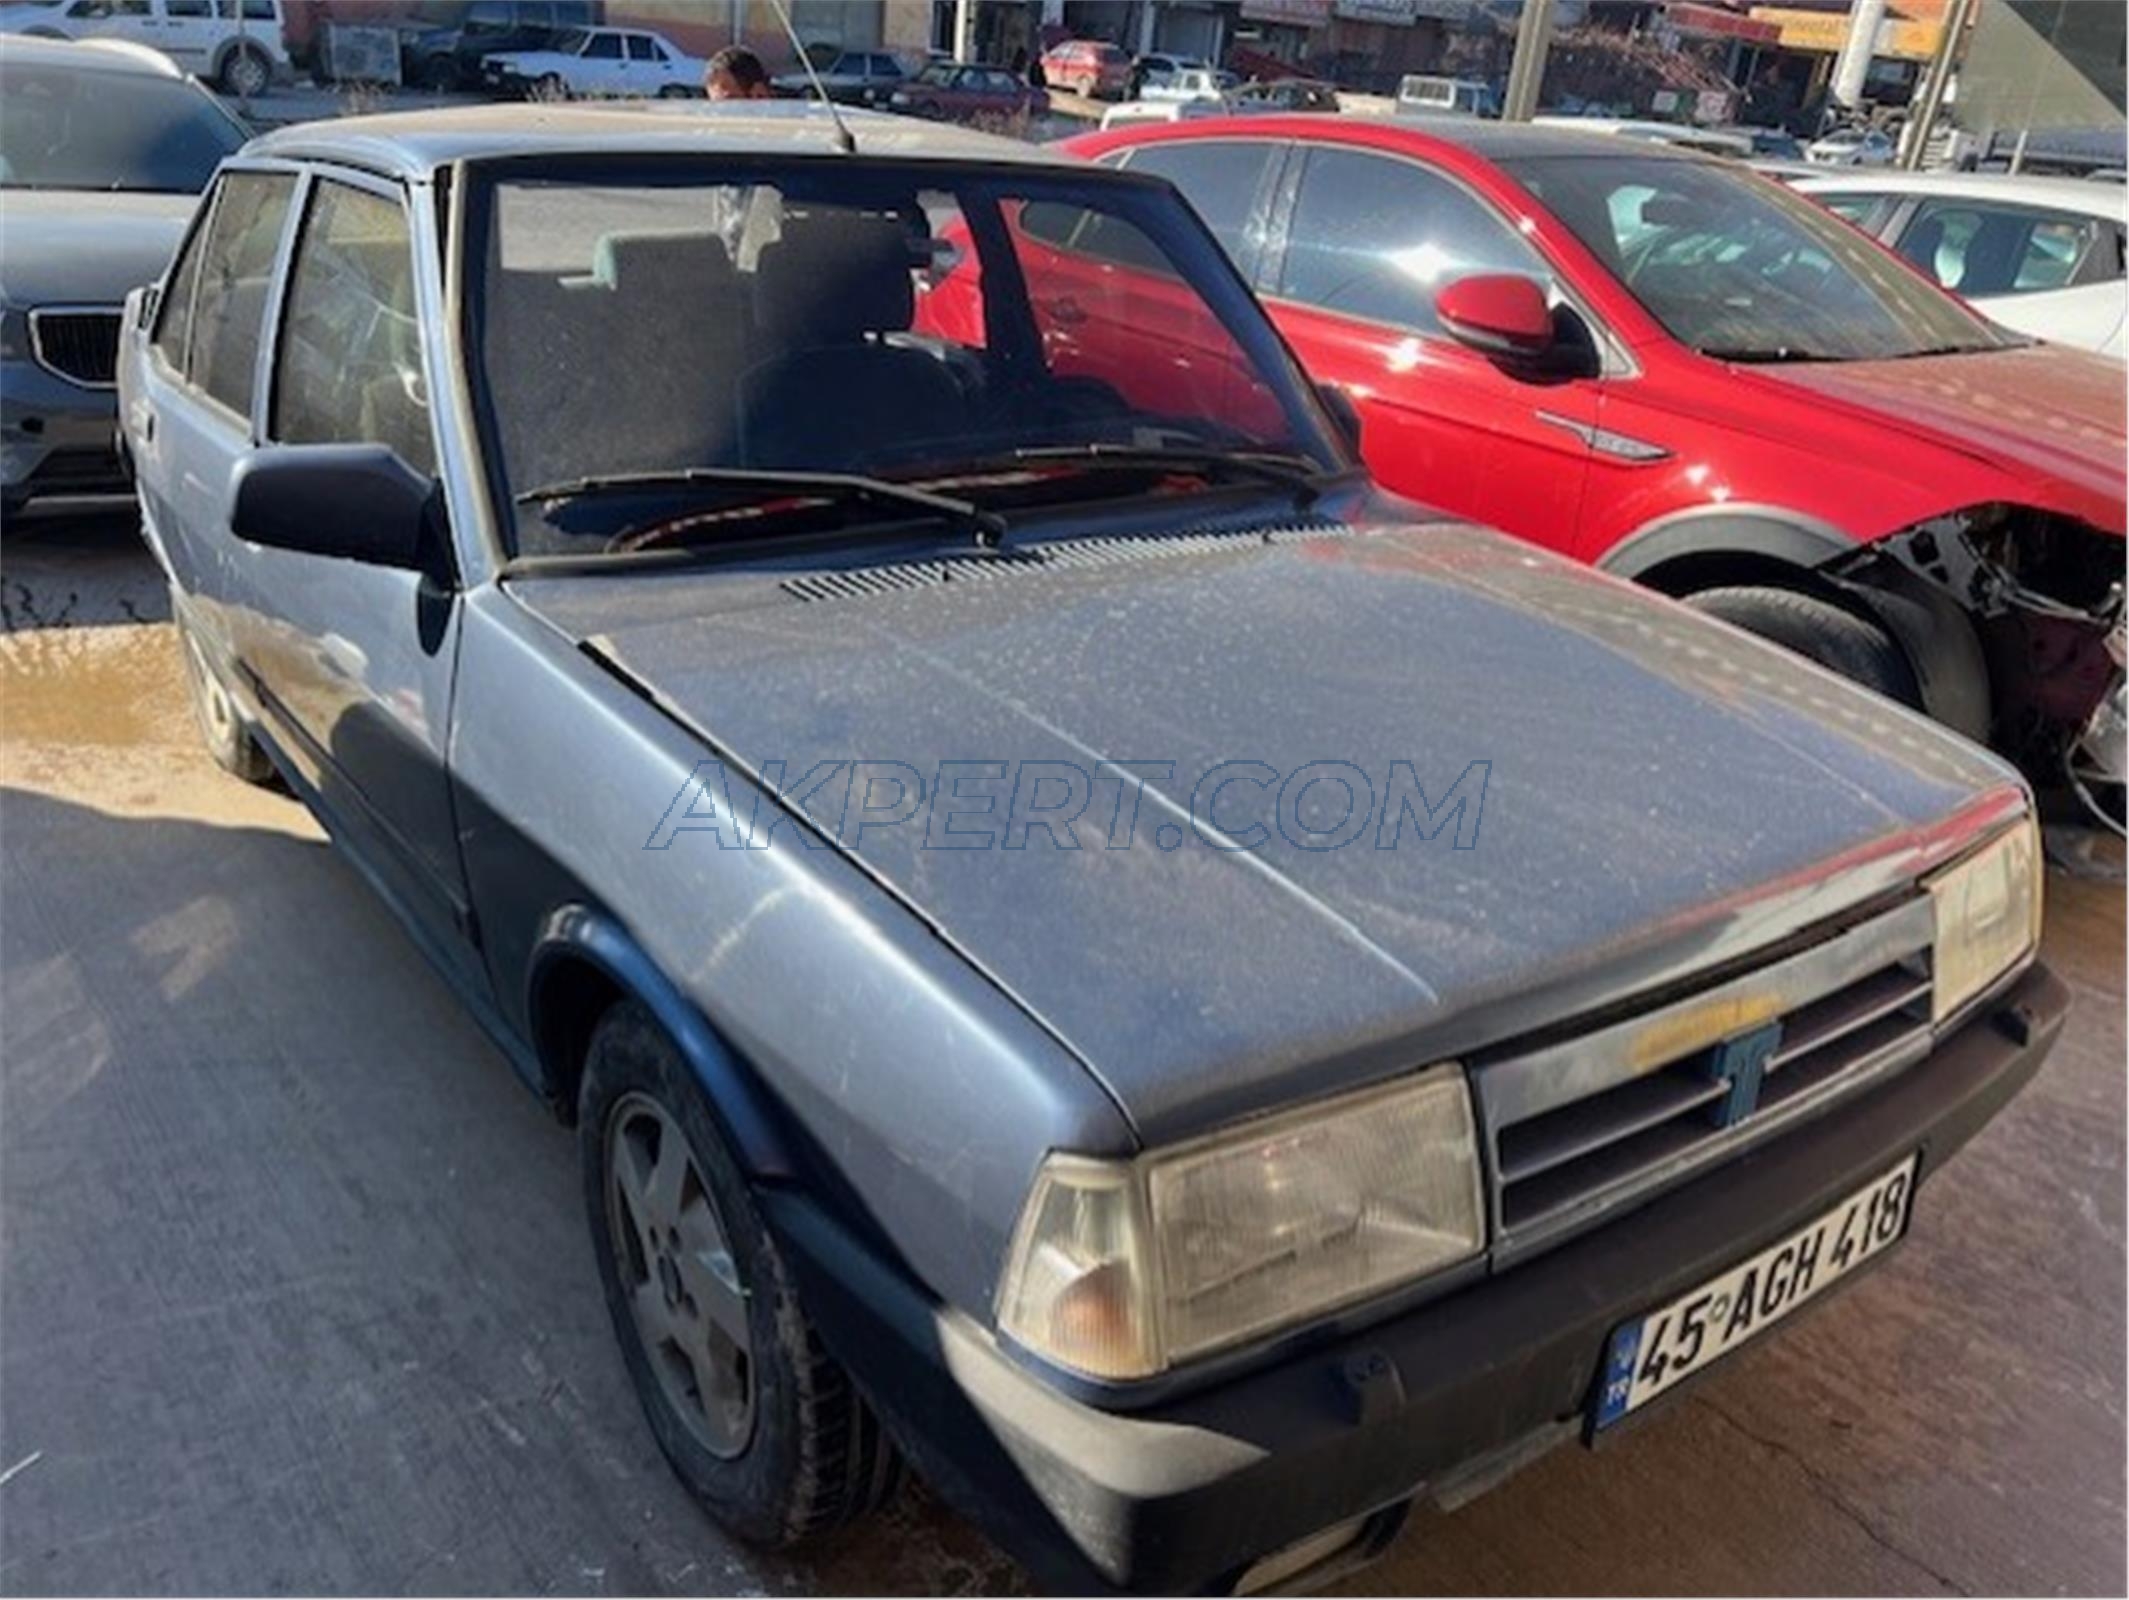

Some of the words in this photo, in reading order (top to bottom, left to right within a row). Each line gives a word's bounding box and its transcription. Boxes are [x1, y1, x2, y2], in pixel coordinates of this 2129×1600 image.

[1638, 1294, 1713, 1386] 45
[1723, 1228, 1826, 1344] AGH
[1830, 1172, 1906, 1270] 418
